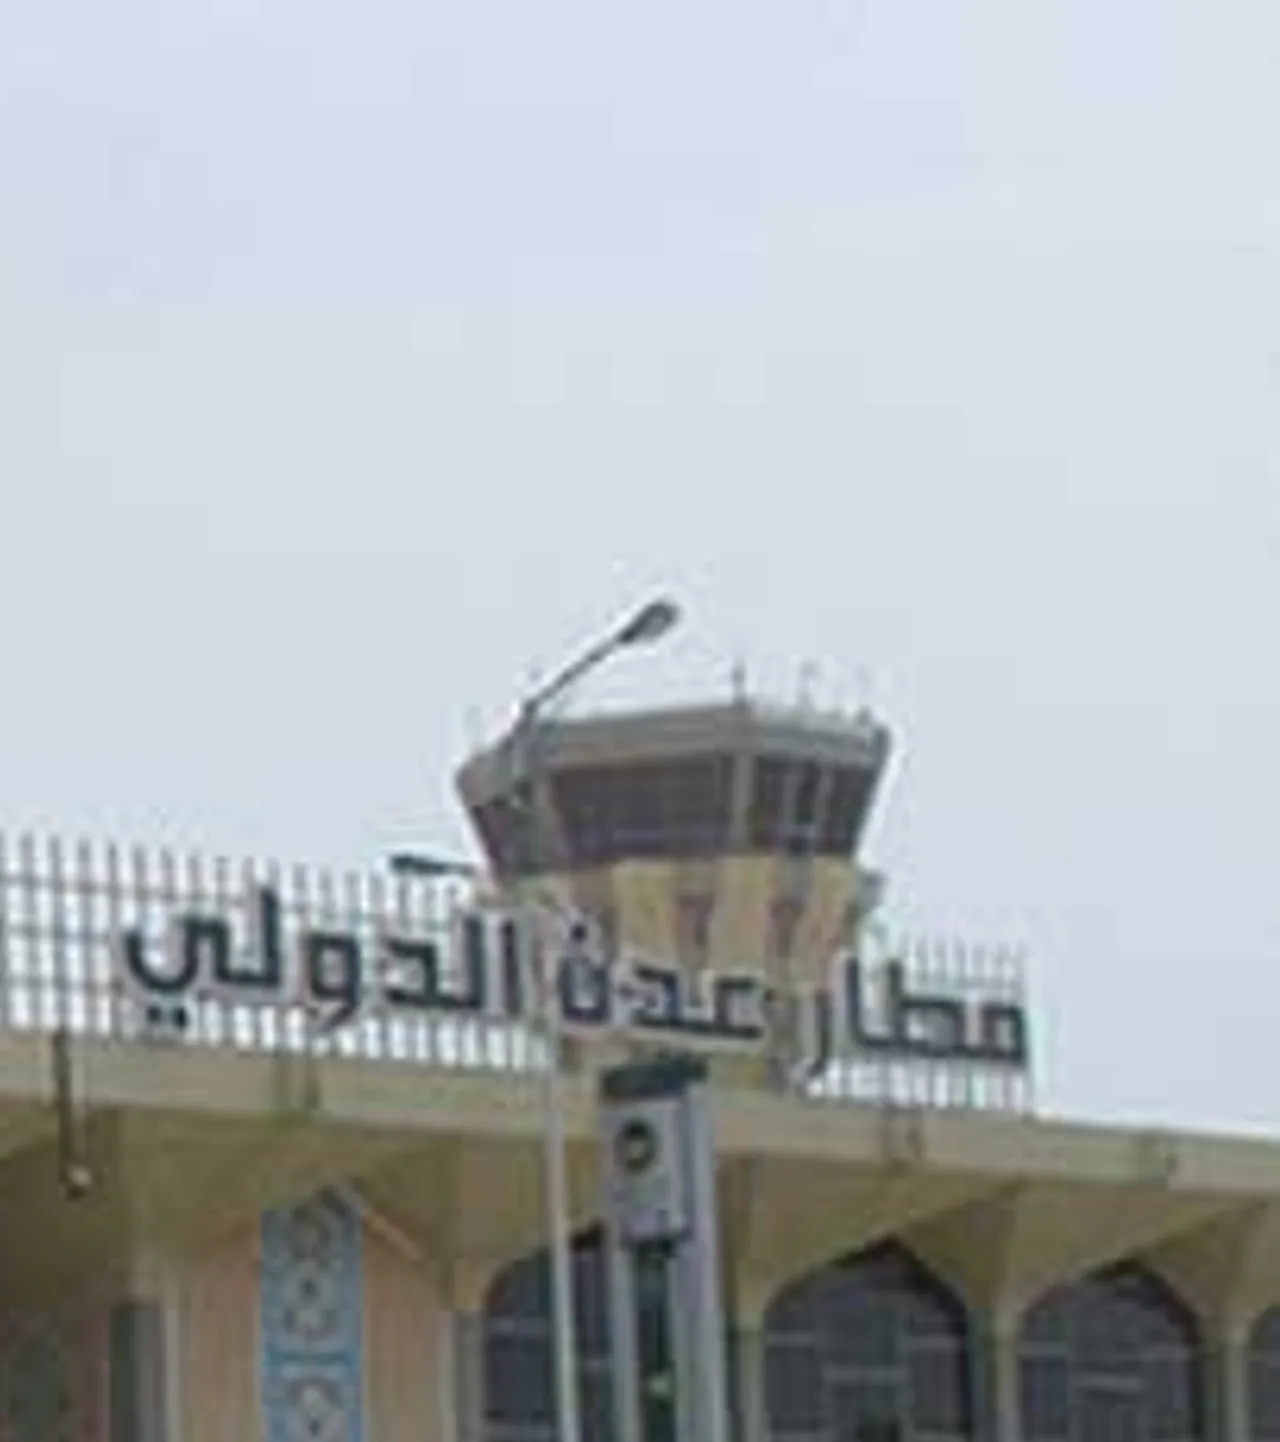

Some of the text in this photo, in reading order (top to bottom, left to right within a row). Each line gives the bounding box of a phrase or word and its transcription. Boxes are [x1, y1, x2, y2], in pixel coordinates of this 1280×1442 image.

[125, 886, 1028, 1078] مطار عدن الدولي
